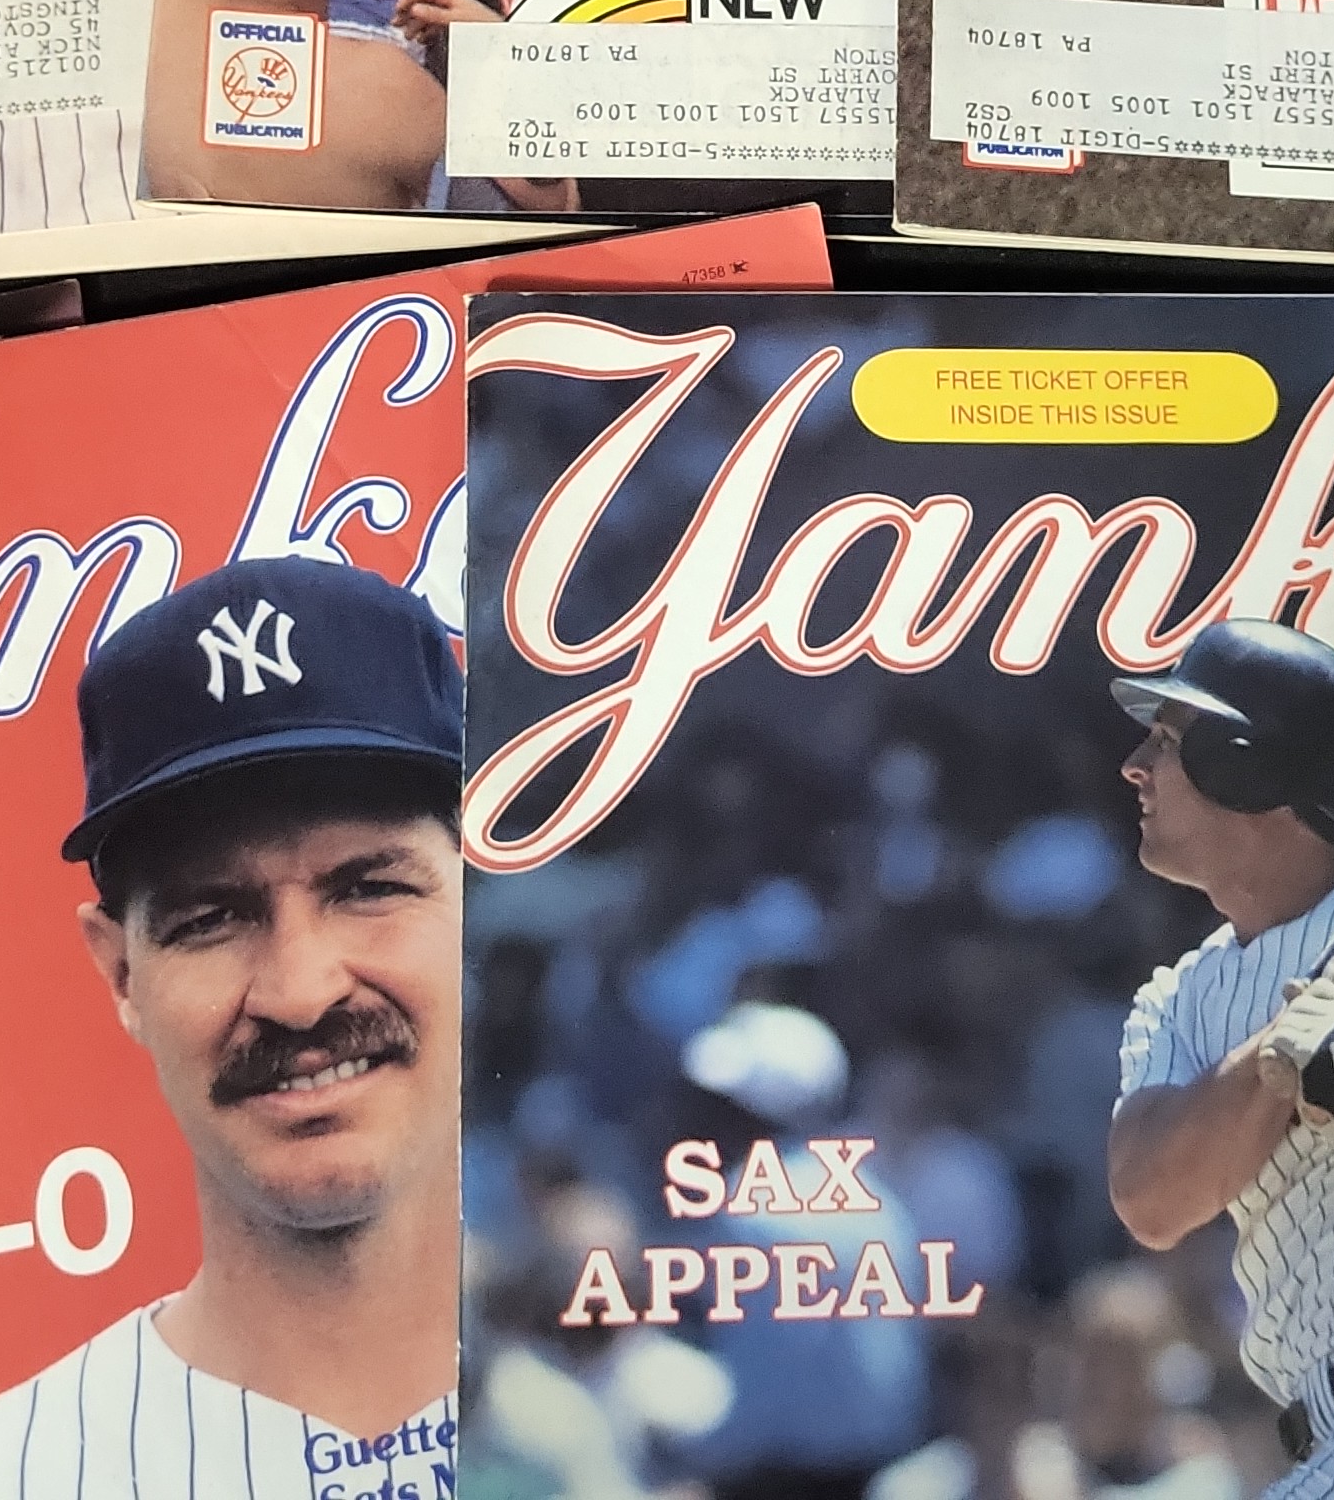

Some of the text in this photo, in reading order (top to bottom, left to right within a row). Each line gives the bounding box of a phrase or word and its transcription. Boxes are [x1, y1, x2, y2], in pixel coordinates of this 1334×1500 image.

[219, 22, 306, 44] OFFICIAL
[968, 27, 1044, 51] 18704
[36, 33, 101, 55] NICK
[509, 43, 638, 62] PA 18704
[1061, 34, 1091, 54] PA
[768, 66, 797, 84] ST
[1222, 62, 1253, 80] ST
[768, 86, 880, 105] ALAPACK
[1030, 88, 1090, 110] 1009
[1111, 95, 1172, 117] 1005
[575, 102, 799, 124] 1501 1001 1009
[965, 102, 1013, 123] CSZ
[1192, 100, 1253, 121] 1501
[215, 122, 304, 140] PUBLICATION
[508, 120, 559, 140] TQZ
[966, 120, 1044, 145] 18704
[508, 140, 589, 158] 18704
[681, 265, 727, 285] 47358
[936, 369, 1188, 391] FREE TICKET OFFER
[950, 404, 1178, 425] INSIDE THIS ISSUE
[664, 1137, 882, 1219] SAX
[559, 1240, 984, 1327] APPEAL
